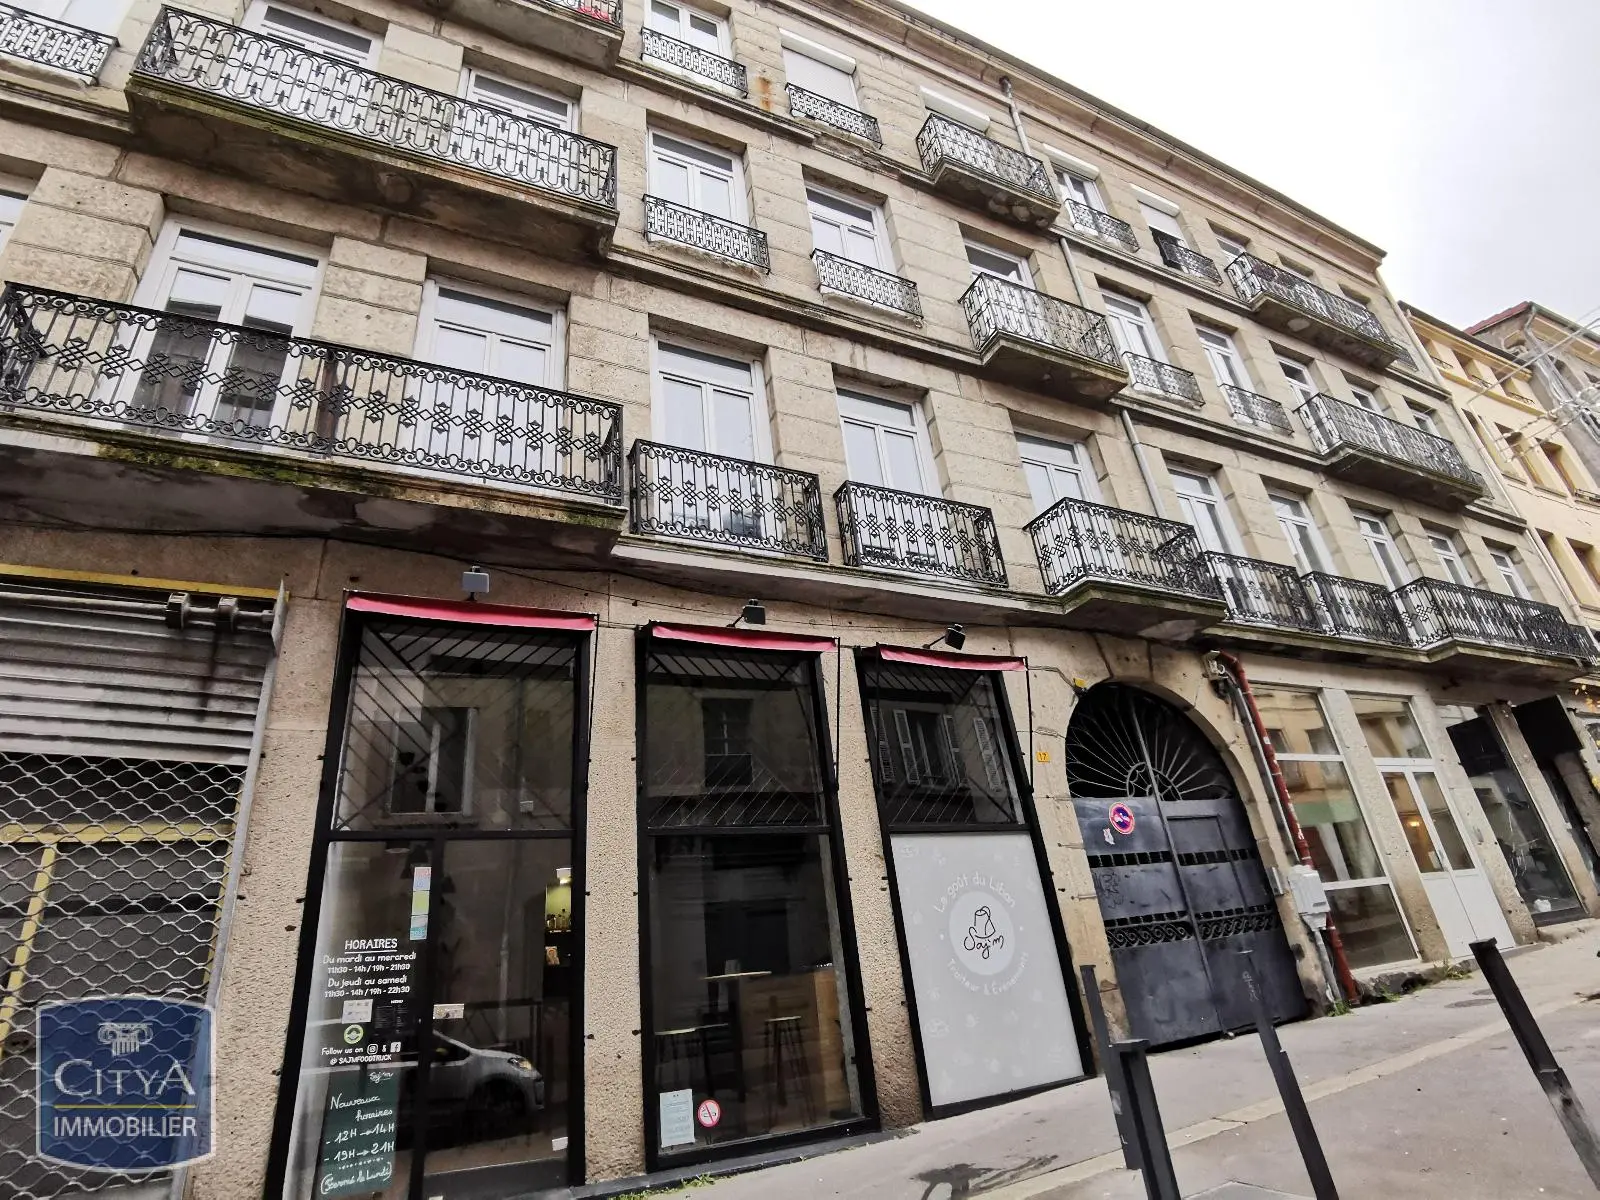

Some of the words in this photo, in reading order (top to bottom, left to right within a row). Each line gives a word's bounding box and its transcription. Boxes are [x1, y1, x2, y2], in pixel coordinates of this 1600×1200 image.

[972, 871, 986, 885] du
[989, 877, 1016, 908] Liban
[344, 938, 398, 950] HORAIRES
[322, 954, 335, 964] Du
[336, 953, 362, 963] mardi
[377, 950, 417, 962] mercredi
[327, 966, 348, 974] 11h30
[390, 963, 411, 971] 21h30
[328, 978, 339, 987] Du
[340, 976, 362, 988] jeudi
[377, 974, 407, 984] samedi
[324, 990, 345, 998] 11h30
[387, 986, 410, 994] 22h30
[321, 1047, 343, 1056] Follow
[329, 1057, 338, 1066] @
[330, 1093, 381, 1110] Nouveaux
[355, 1109, 393, 1122] horaires
[334, 1128, 357, 1143] 12H
[372, 1122, 395, 1135] 14H
[333, 1148, 356, 1162] 19H
[370, 1141, 395, 1155] 21H
